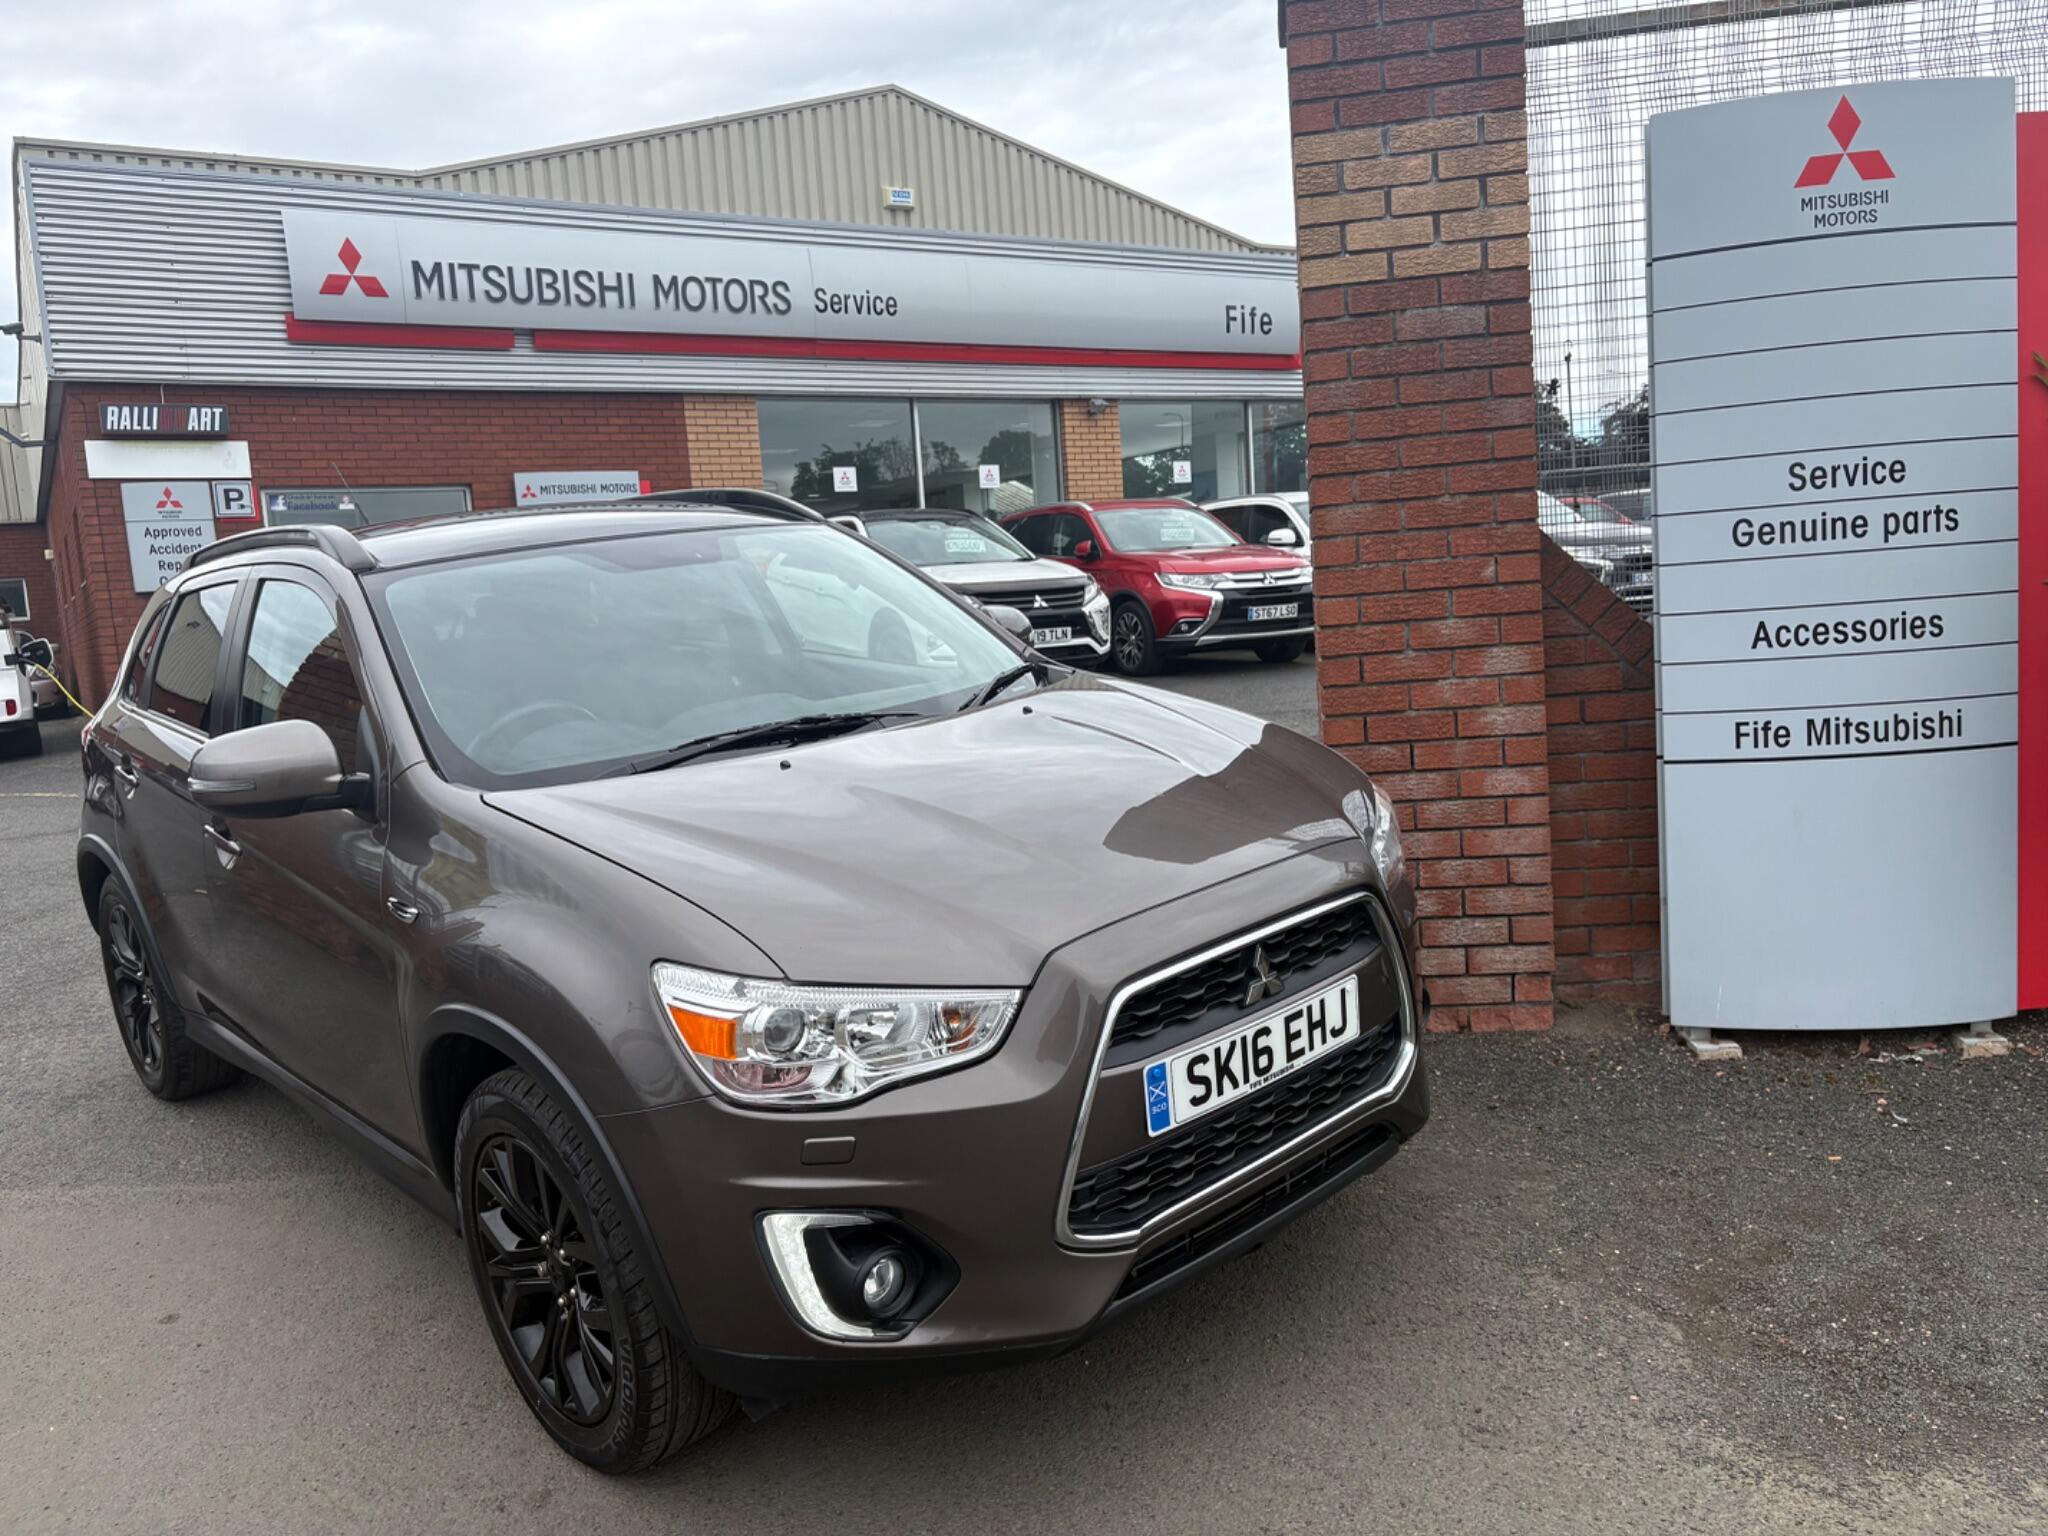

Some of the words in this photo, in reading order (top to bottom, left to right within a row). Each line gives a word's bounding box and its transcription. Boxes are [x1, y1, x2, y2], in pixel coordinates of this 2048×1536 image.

[1800, 189, 1889, 212] MITSUBISHI
[1813, 208, 1878, 229] MOTORS
[411, 260, 636, 309] MITSUBISHI
[653, 273, 792, 316] MOTORS
[814, 288, 898, 317] Service
[1225, 304, 1273, 335] Fife
[106, 405, 158, 431] RALLI
[187, 407, 223, 431] ART
[1788, 456, 1907, 492] Service
[540, 484, 597, 496] MITSUBISHI
[600, 482, 638, 494] MOTORS
[144, 525, 202, 540] Approved
[1732, 511, 1869, 547] Genuine
[1883, 504, 1960, 543] parts
[149, 543, 202, 555] Accident
[1254, 606, 1278, 618] ST67
[1049, 628, 1068, 640] TLN
[1751, 611, 1944, 649] Accessories
[1734, 719, 1791, 749] Fife
[1806, 708, 1963, 746] Mitsubishi
[1187, 1027, 1273, 1107] SK16
[1284, 987, 1346, 1063] EHJ
